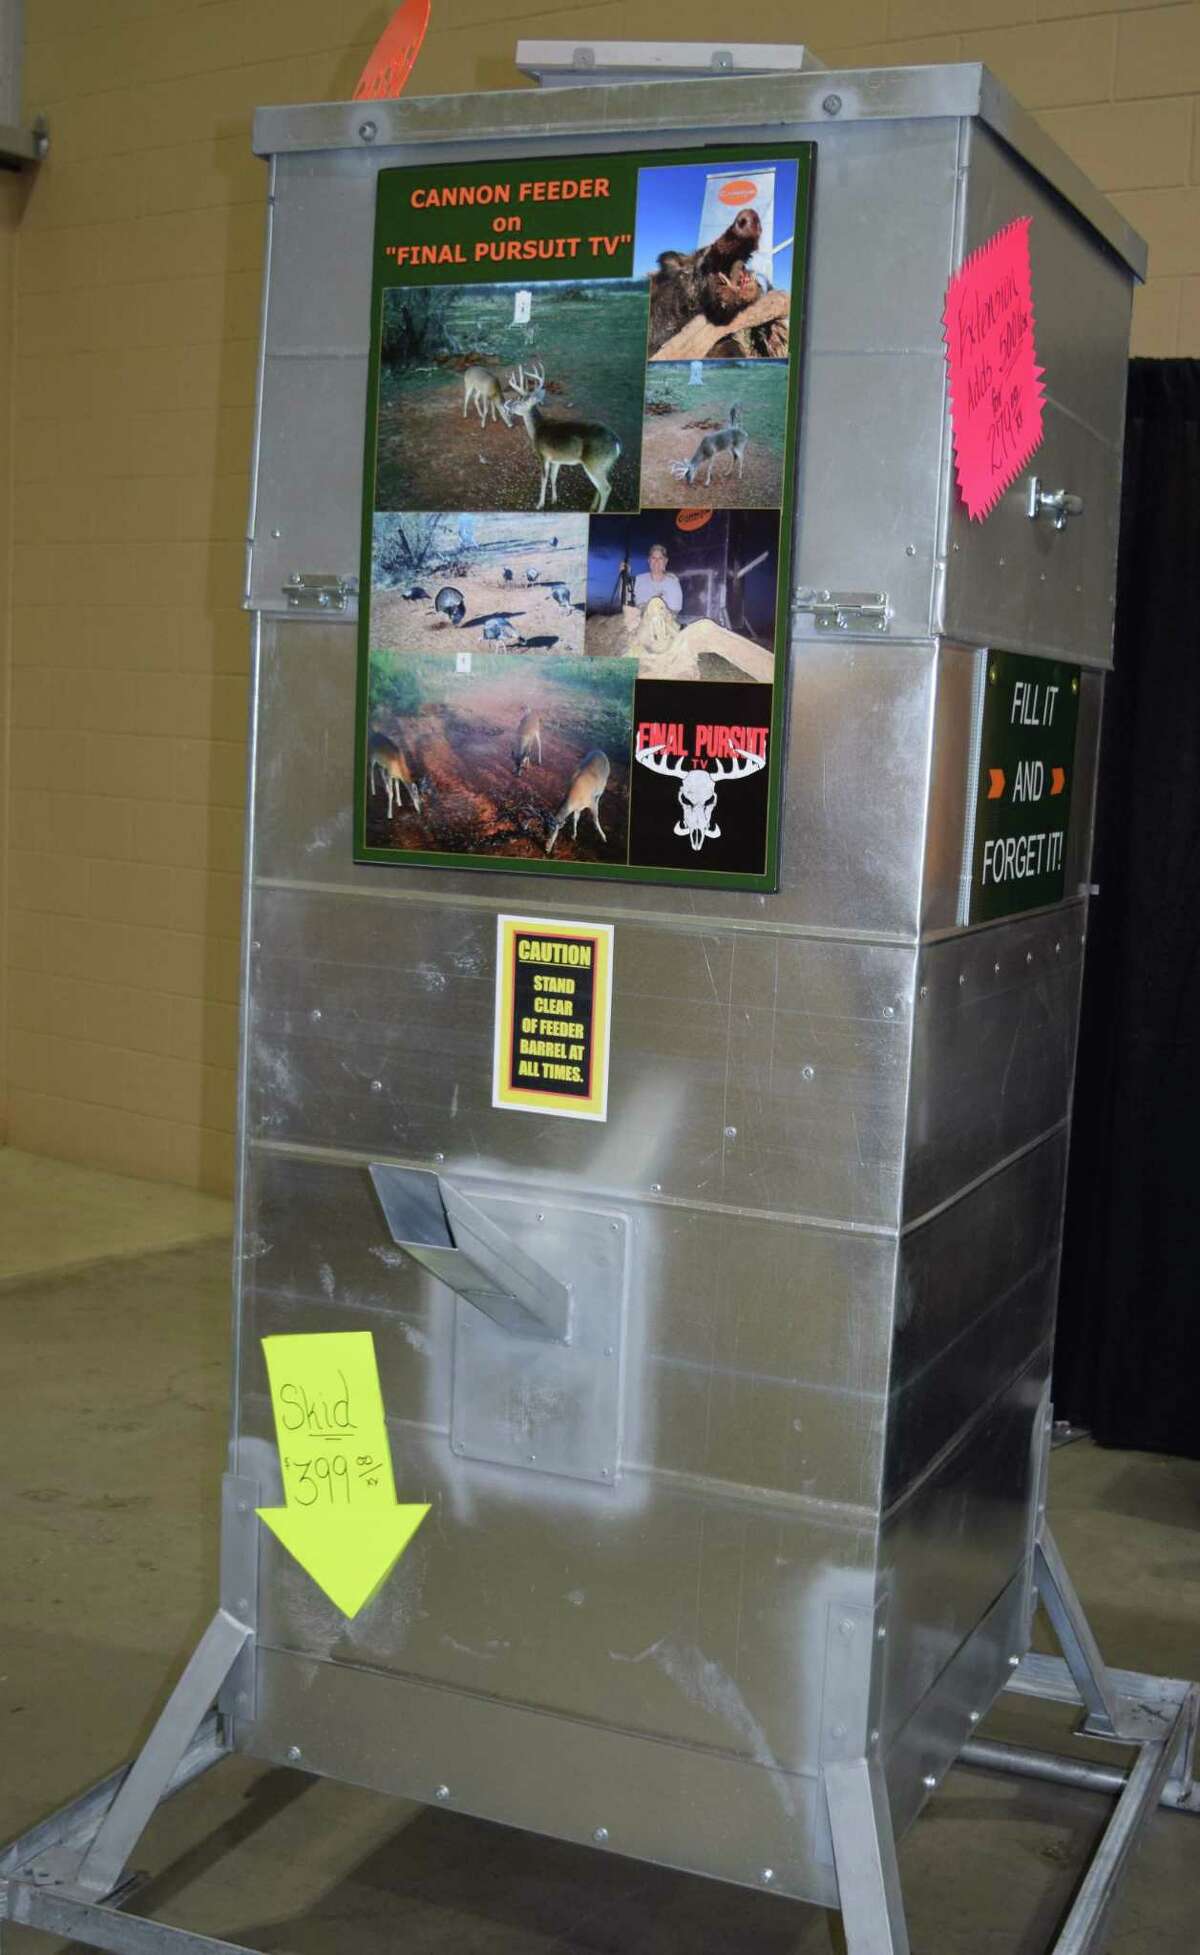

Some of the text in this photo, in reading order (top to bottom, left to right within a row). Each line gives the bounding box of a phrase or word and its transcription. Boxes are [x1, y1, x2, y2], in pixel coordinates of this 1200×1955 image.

[410, 178, 610, 209] CANNON FEEDER
[492, 216, 521, 233] on
[386, 234, 632, 265] "FINAL PURSUIT TV"
[1010, 682, 1059, 727] FILL IT
[638, 722, 769, 759] FINAL PURSUIT
[691, 760, 708, 769] TV
[1012, 760, 1044, 803] AND
[981, 831, 1064, 886] FORGET IT!
[518, 940, 592, 967] CAUTION
[533, 975, 576, 995] STAND
[533, 997, 573, 1016] CLEAR
[522, 1018, 584, 1040] OF FEEDER
[519, 1039, 584, 1062] BARREL AT
[518, 1062, 584, 1083] ALL TIMES.
[279, 1368, 358, 1432] Skid
